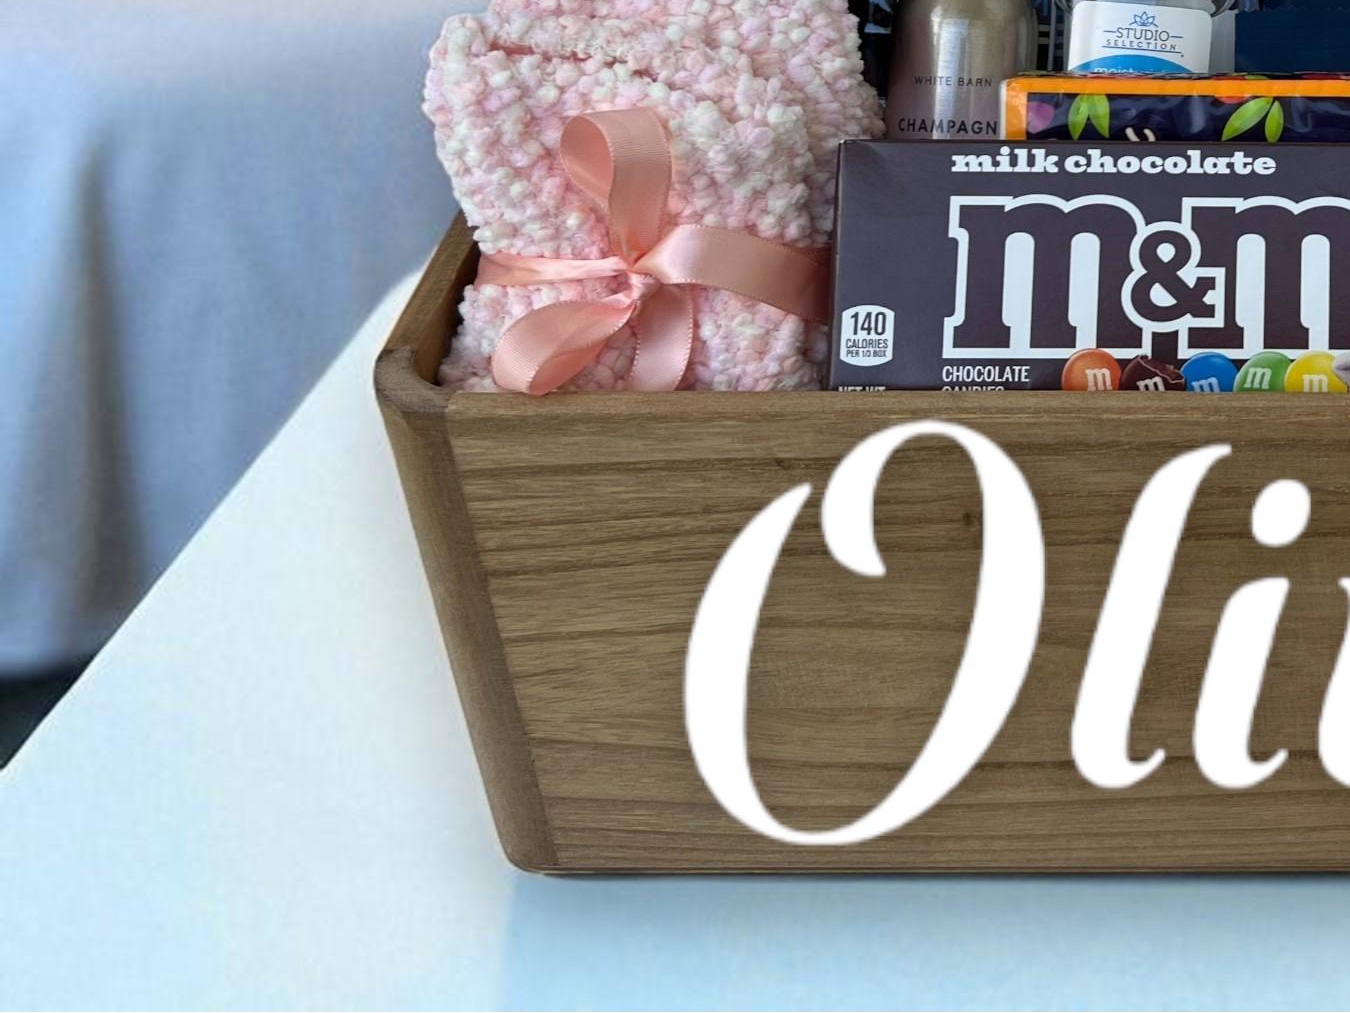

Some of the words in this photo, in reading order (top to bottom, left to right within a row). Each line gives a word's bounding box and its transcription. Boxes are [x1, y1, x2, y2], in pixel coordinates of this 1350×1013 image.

[1116, 27, 1170, 42] STUDIO
[1106, 39, 1177, 51] SELECTION
[914, 76, 952, 86] WHITE
[957, 77, 993, 88] BARN
[951, 145, 1059, 174] milk
[1064, 148, 1277, 176] chocolate
[850, 311, 887, 336] 140
[845, 338, 889, 349] CALORIES
[845, 349, 861, 359] PER
[872, 349, 888, 359] BOX
[942, 365, 1031, 383] CHOCOLATE
[1244, 366, 1273, 390] m
